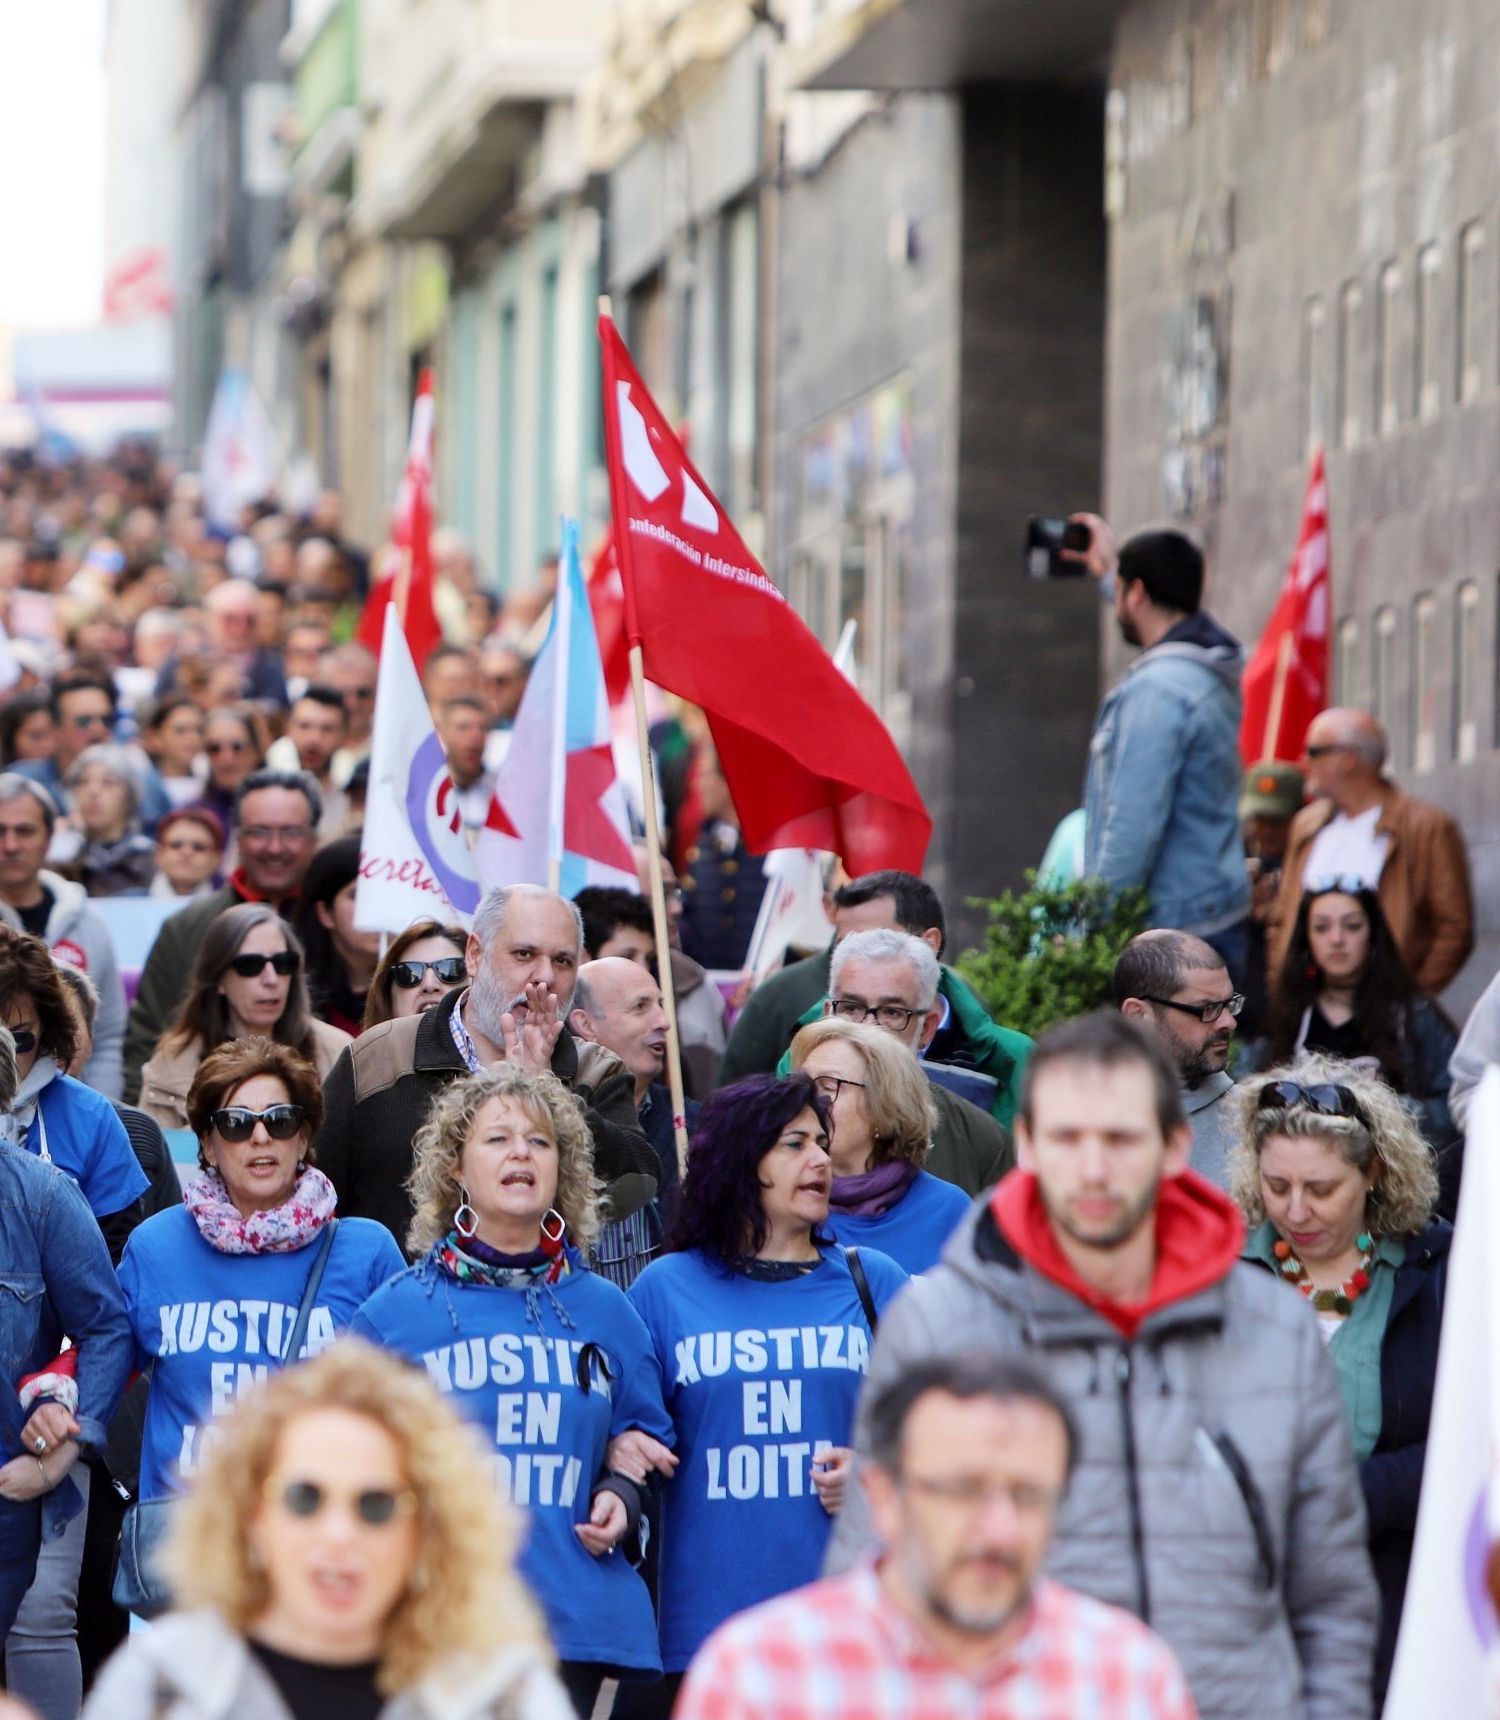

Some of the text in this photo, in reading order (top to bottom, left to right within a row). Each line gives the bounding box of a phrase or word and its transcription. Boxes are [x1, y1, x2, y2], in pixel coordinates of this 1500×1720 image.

[629, 516, 787, 602] onfederación Intersindica
[674, 1324, 871, 1388] XUSTIZA
[496, 1391, 562, 1446] EN
[742, 1378, 802, 1436] EN
